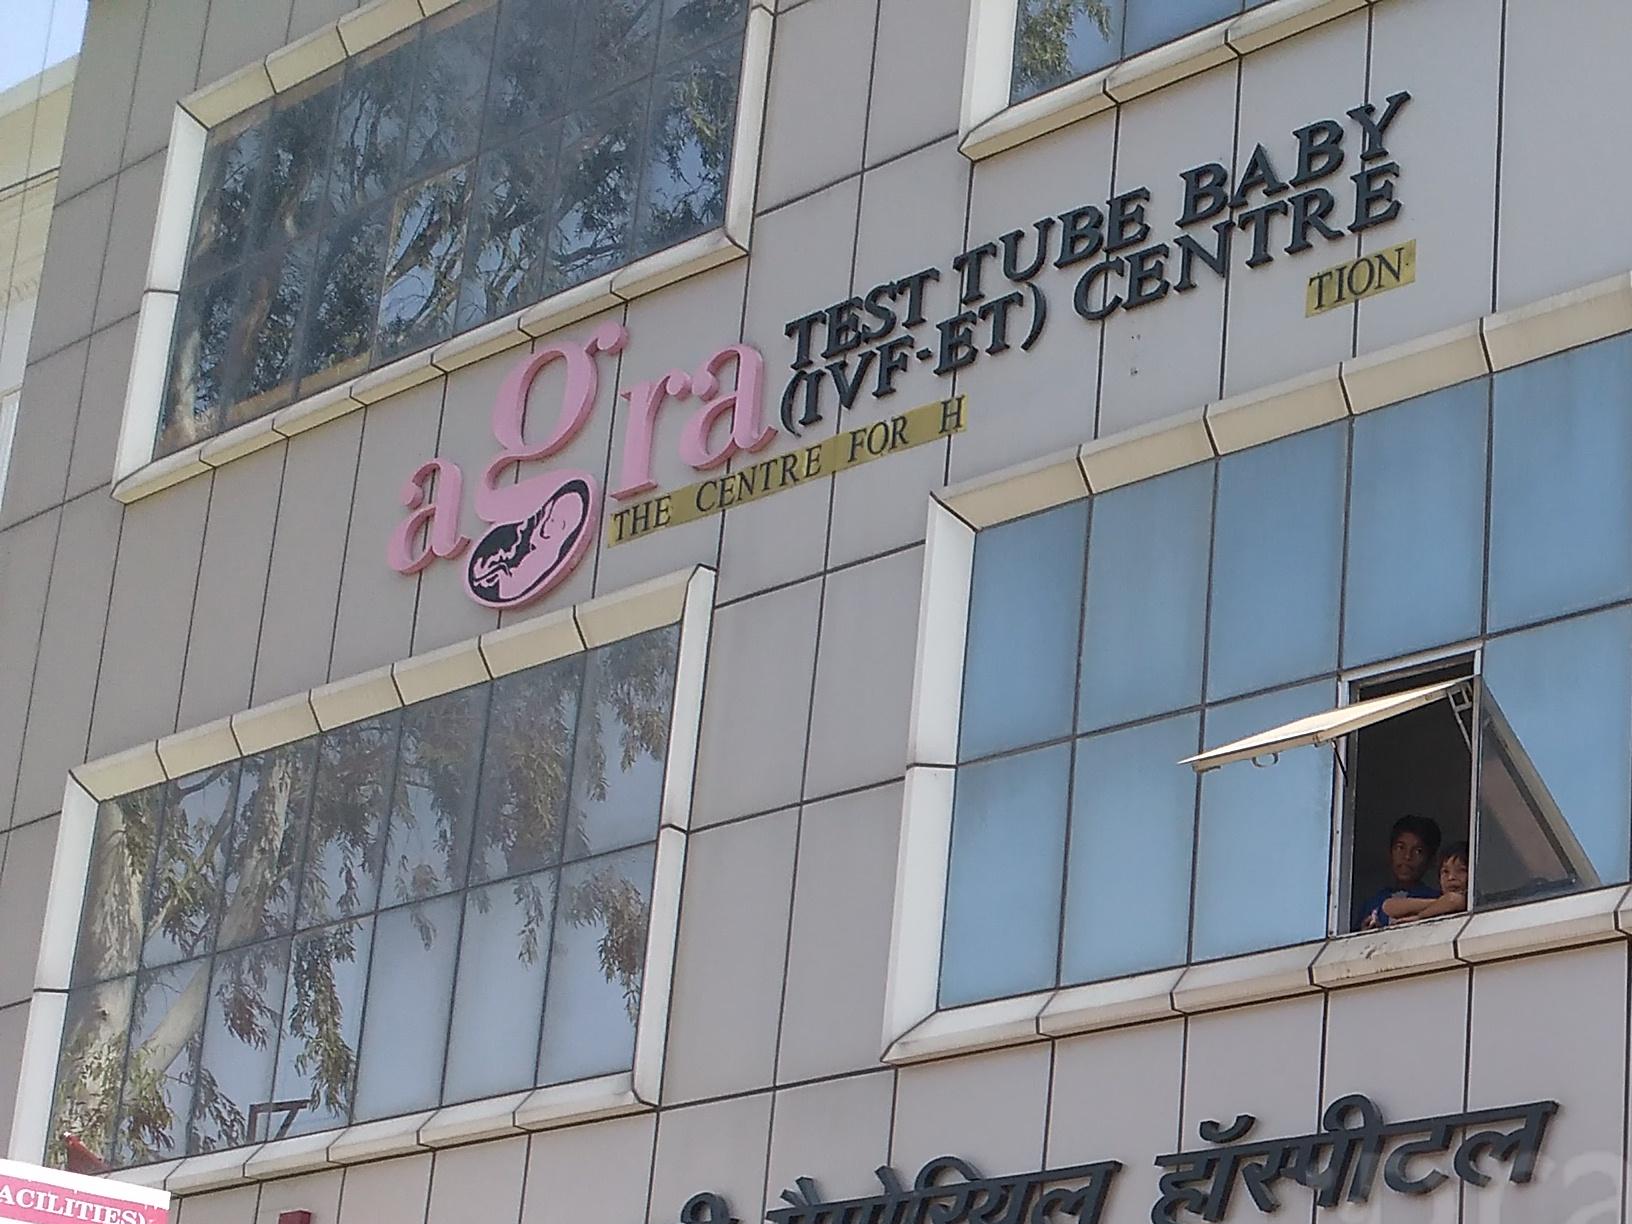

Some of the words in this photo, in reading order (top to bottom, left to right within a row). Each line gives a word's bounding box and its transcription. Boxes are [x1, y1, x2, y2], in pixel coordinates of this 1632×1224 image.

[780, 280, 1047, 439] (IVF-ET)
[1071, 162, 1403, 323] CENTRE
[785, 266, 940, 371] TEST
[952, 185, 1152, 300] TUBE
[1175, 90, 1415, 227] BABY
[1308, 245, 1406, 313] TION
[386, 320, 783, 609] agra
[613, 494, 674, 543] THE
[695, 444, 823, 513] CENTRE
[847, 415, 910, 464] FOR
[939, 394, 967, 435] H
